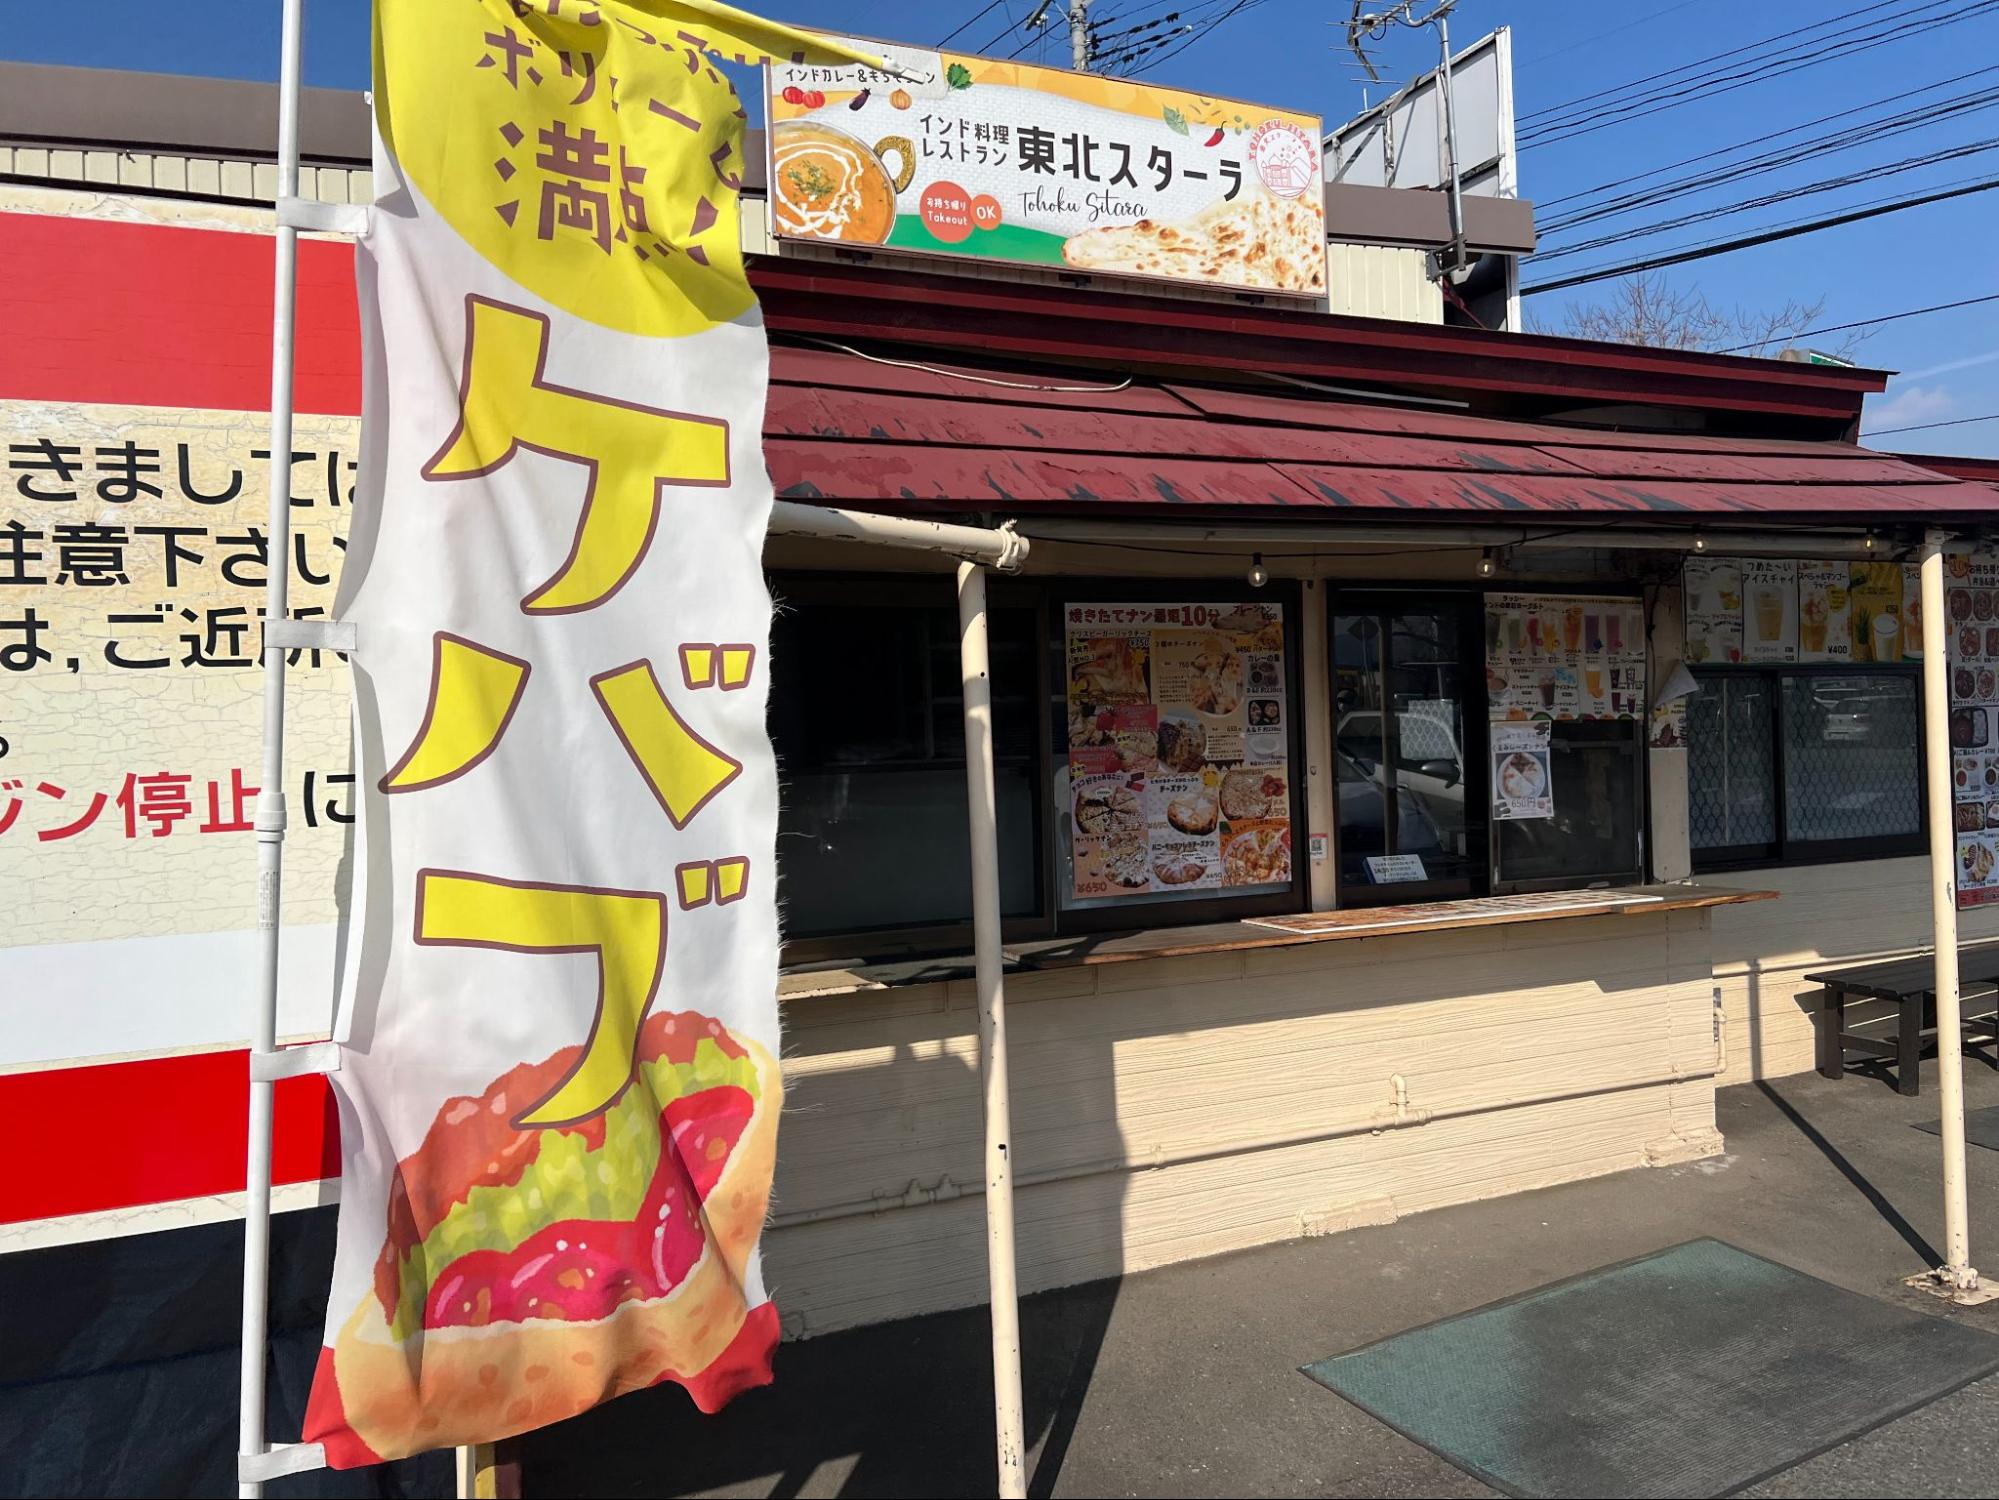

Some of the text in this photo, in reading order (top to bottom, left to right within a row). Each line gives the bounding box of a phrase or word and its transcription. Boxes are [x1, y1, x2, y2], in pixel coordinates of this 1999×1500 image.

[919, 113, 1010, 145] インド料理
[922, 137, 1007, 167] レストラン
[1016, 125, 1243, 202] 東北スターラ
[927, 210, 968, 226] Takeout
[976, 205, 997, 220] OK
[1017, 185, 1149, 223] Tohoku Sitara
[1742, 574, 1795, 584] アイスチャイ
[1828, 645, 1848, 654] ¥400
[378, 293, 760, 1132] ケバブ
